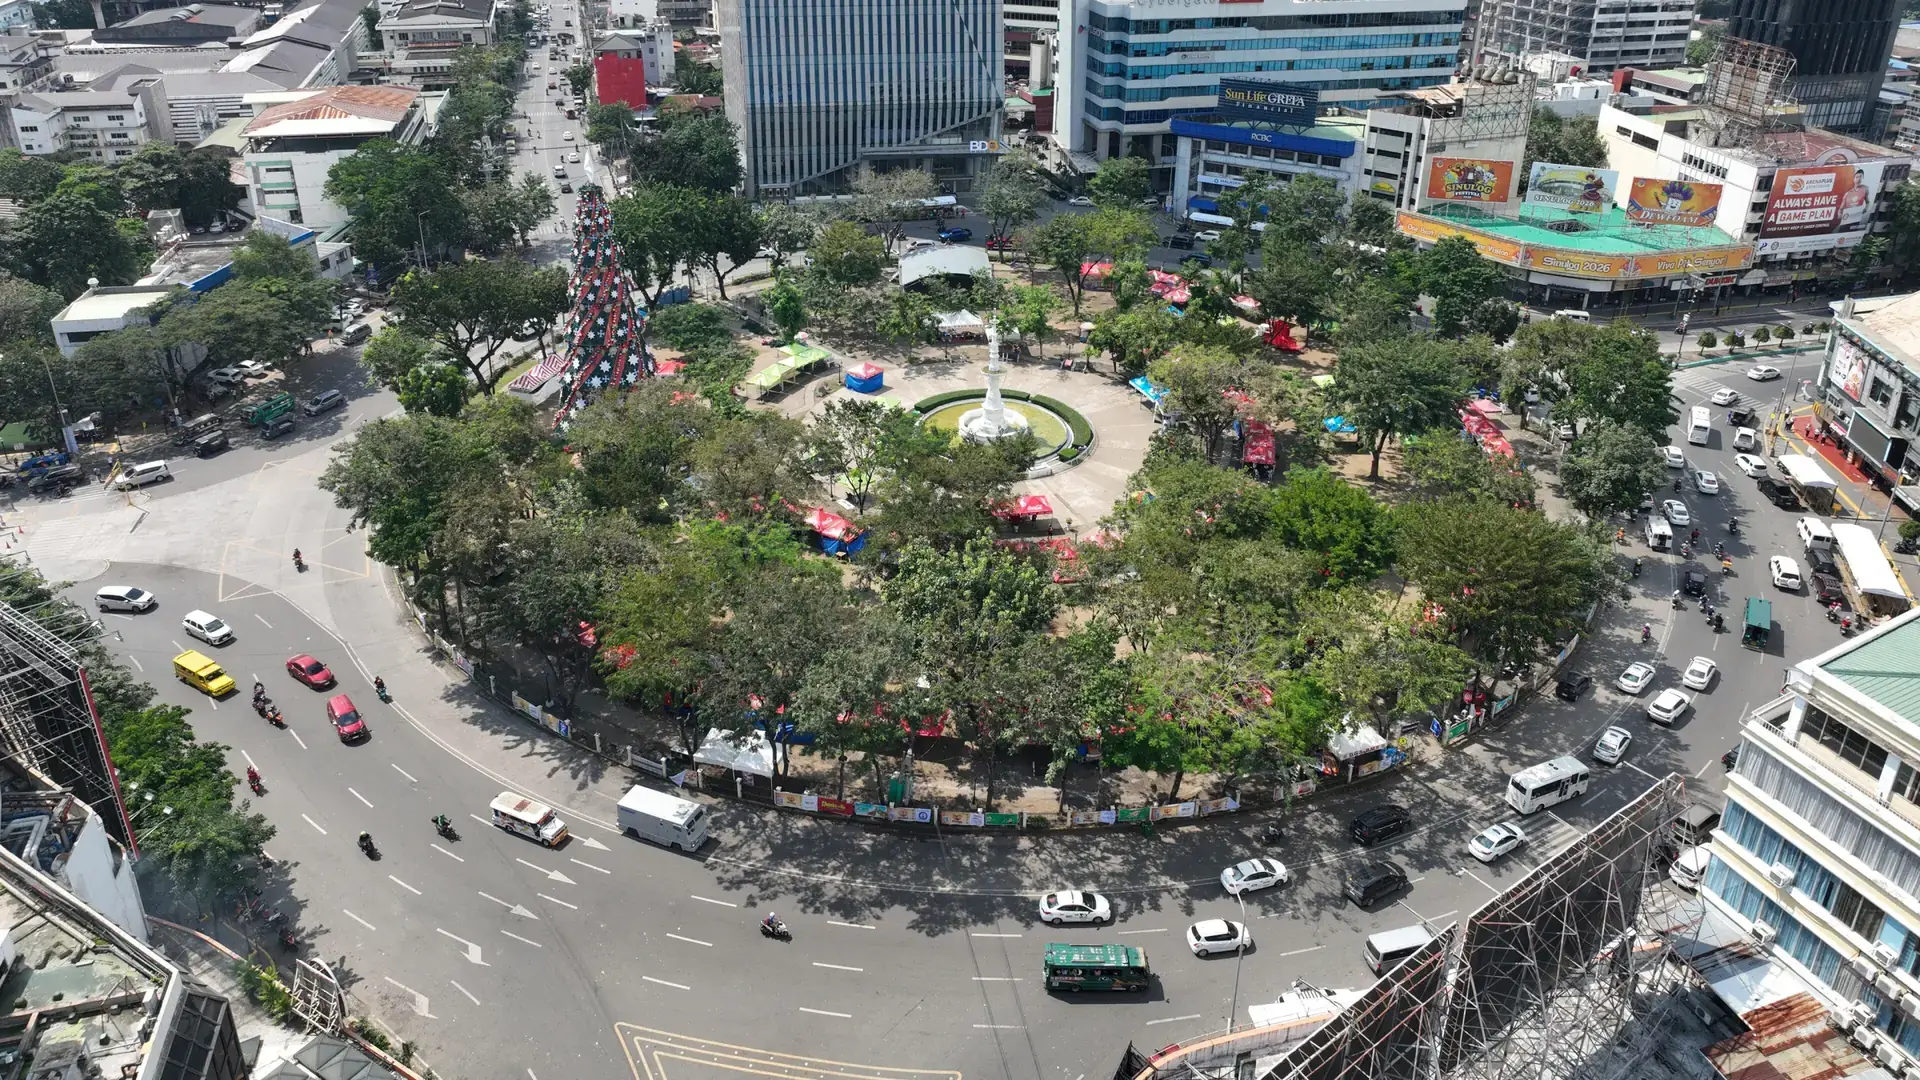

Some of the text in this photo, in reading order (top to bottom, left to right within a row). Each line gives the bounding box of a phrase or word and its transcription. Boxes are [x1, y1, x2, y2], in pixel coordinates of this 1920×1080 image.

[1225, 88, 1305, 107] Sun Life GREPA
[1236, 102, 1293, 113] Financial
[1251, 132, 1272, 142] RCBC
[970, 140, 998, 151] BDO
[1446, 183, 1492, 194] SINULOG
[1534, 194, 1574, 204] SINULOG
[1773, 195, 1838, 209] ALWAYS HAVE
[1640, 211, 1699, 223] DEWFOAM
[1768, 209, 1833, 222] A GAME PLAN
[1543, 256, 1581, 271] Sinulog
[1582, 262, 1611, 272] 2026
[1657, 262, 1674, 270] Viva
